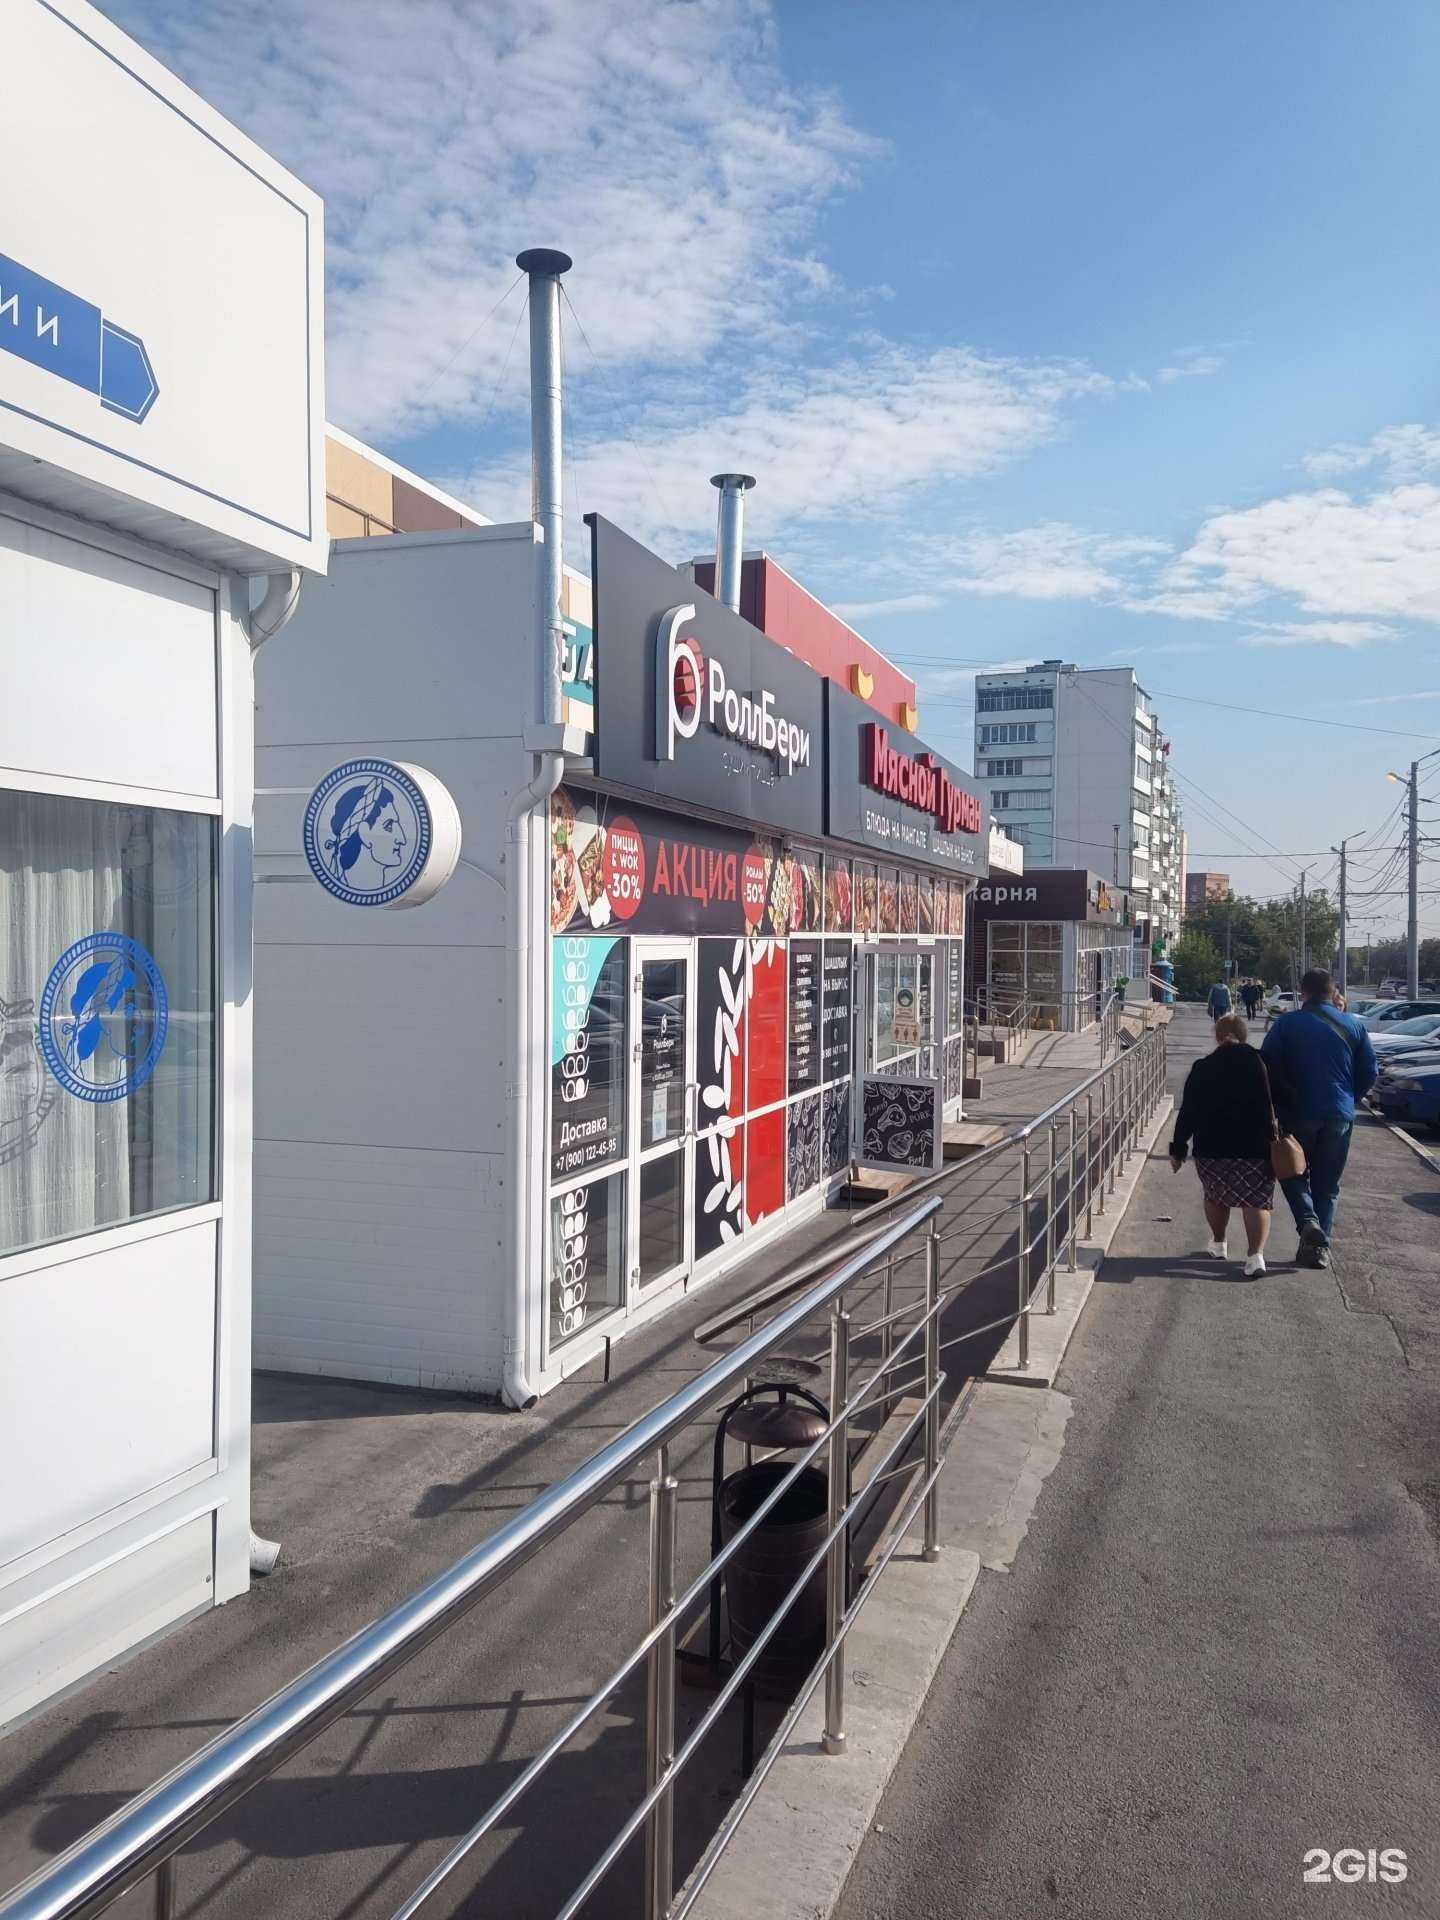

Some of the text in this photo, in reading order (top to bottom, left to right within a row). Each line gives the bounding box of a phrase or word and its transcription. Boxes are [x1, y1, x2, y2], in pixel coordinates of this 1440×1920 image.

[708, 657, 810, 777] РоллБери
[873, 722, 982, 834] Мясной Гурман
[866, 810, 891, 840] БЛЮДА
[611, 834, 639, 855] ПИЦЦА
[620, 854, 639, 870] WOK
[652, 839, 737, 908] АКЦИЯ
[607, 872, 641, 900] -30%
[743, 882, 765, 904] -50%
[560, 1116, 608, 1149] Доставка
[556, 1137, 617, 1172] +7 (900) 122-45-95
